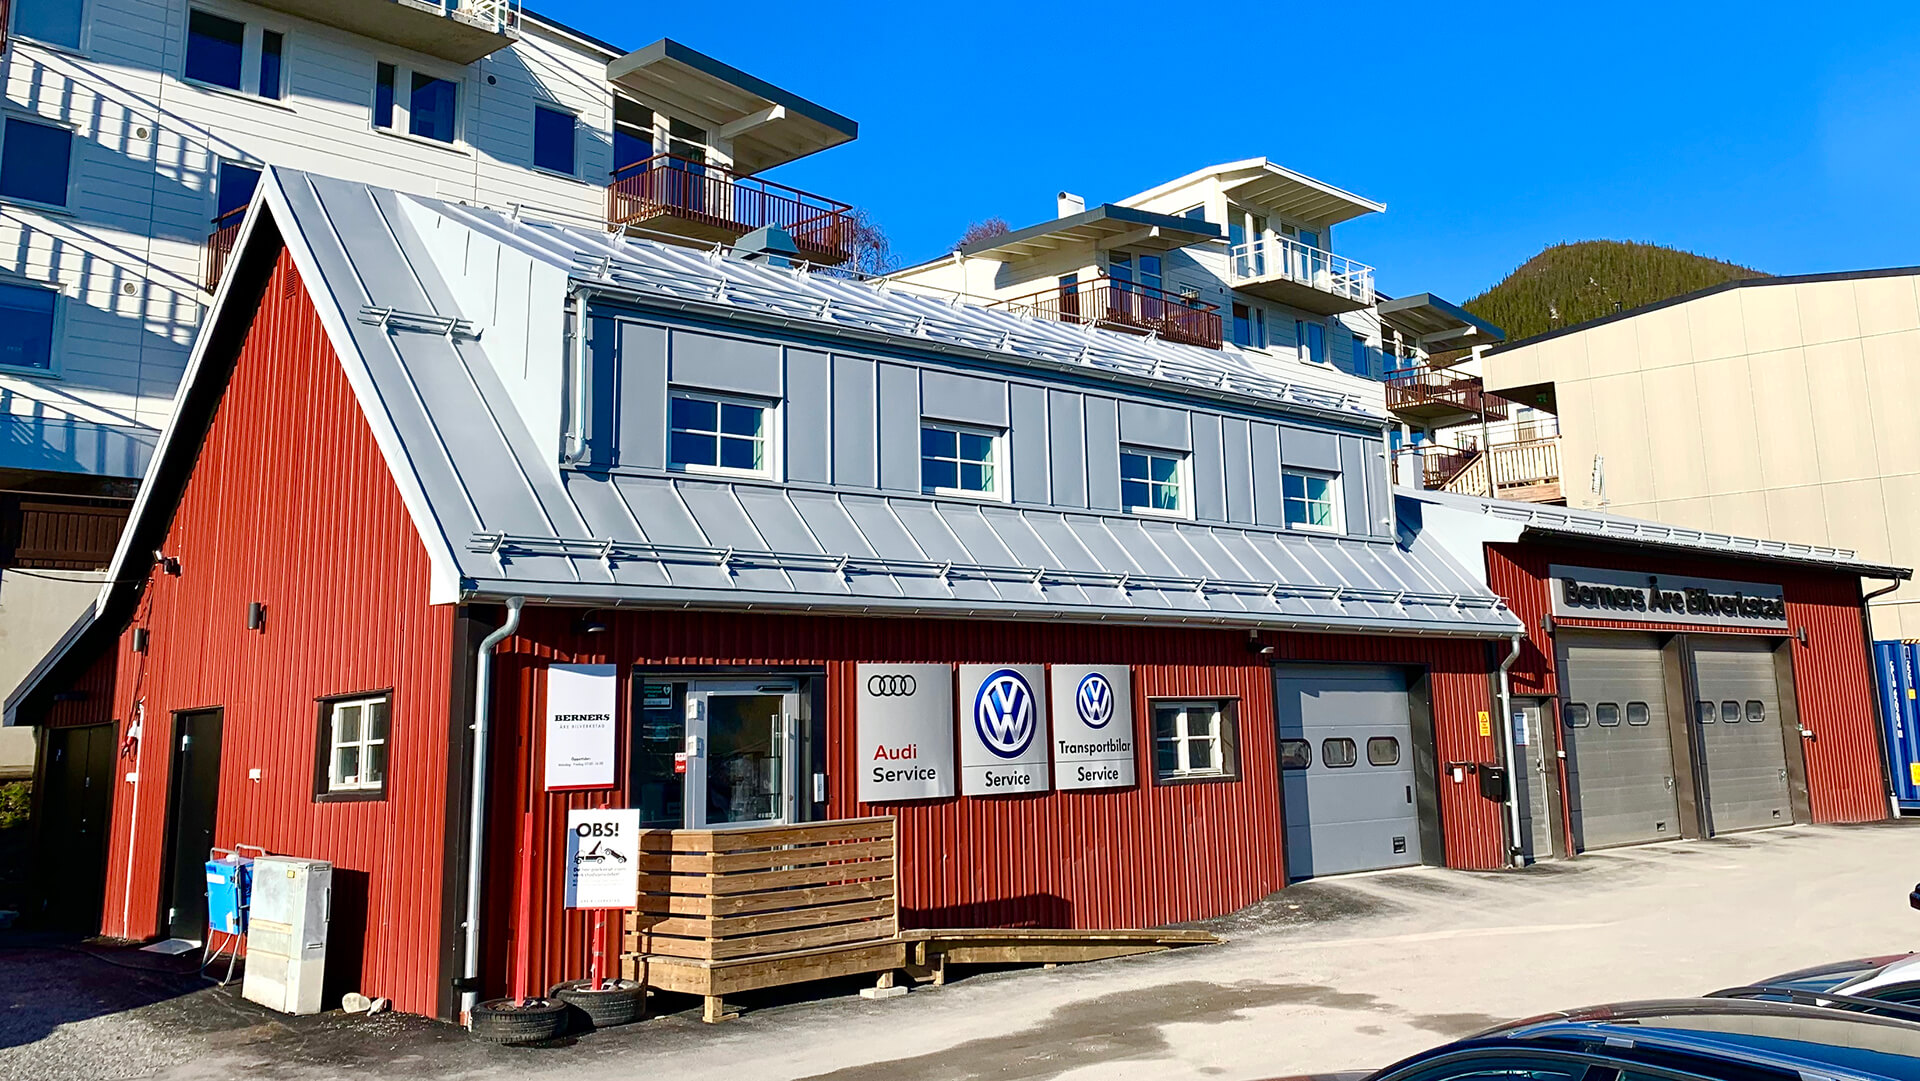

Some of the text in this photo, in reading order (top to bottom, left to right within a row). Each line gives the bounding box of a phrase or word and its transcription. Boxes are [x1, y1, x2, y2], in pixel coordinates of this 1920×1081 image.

[1561, 576, 1786, 620] Berners Åre Bilverkstad
[554, 713, 610, 721] BERNERS
[873, 743, 917, 761] Audi
[1058, 738, 1131, 756] Transportbilar
[872, 765, 936, 783] Service
[985, 770, 1031, 788] Service
[1077, 766, 1119, 782] Service
[576, 822, 619, 838] OBS!
